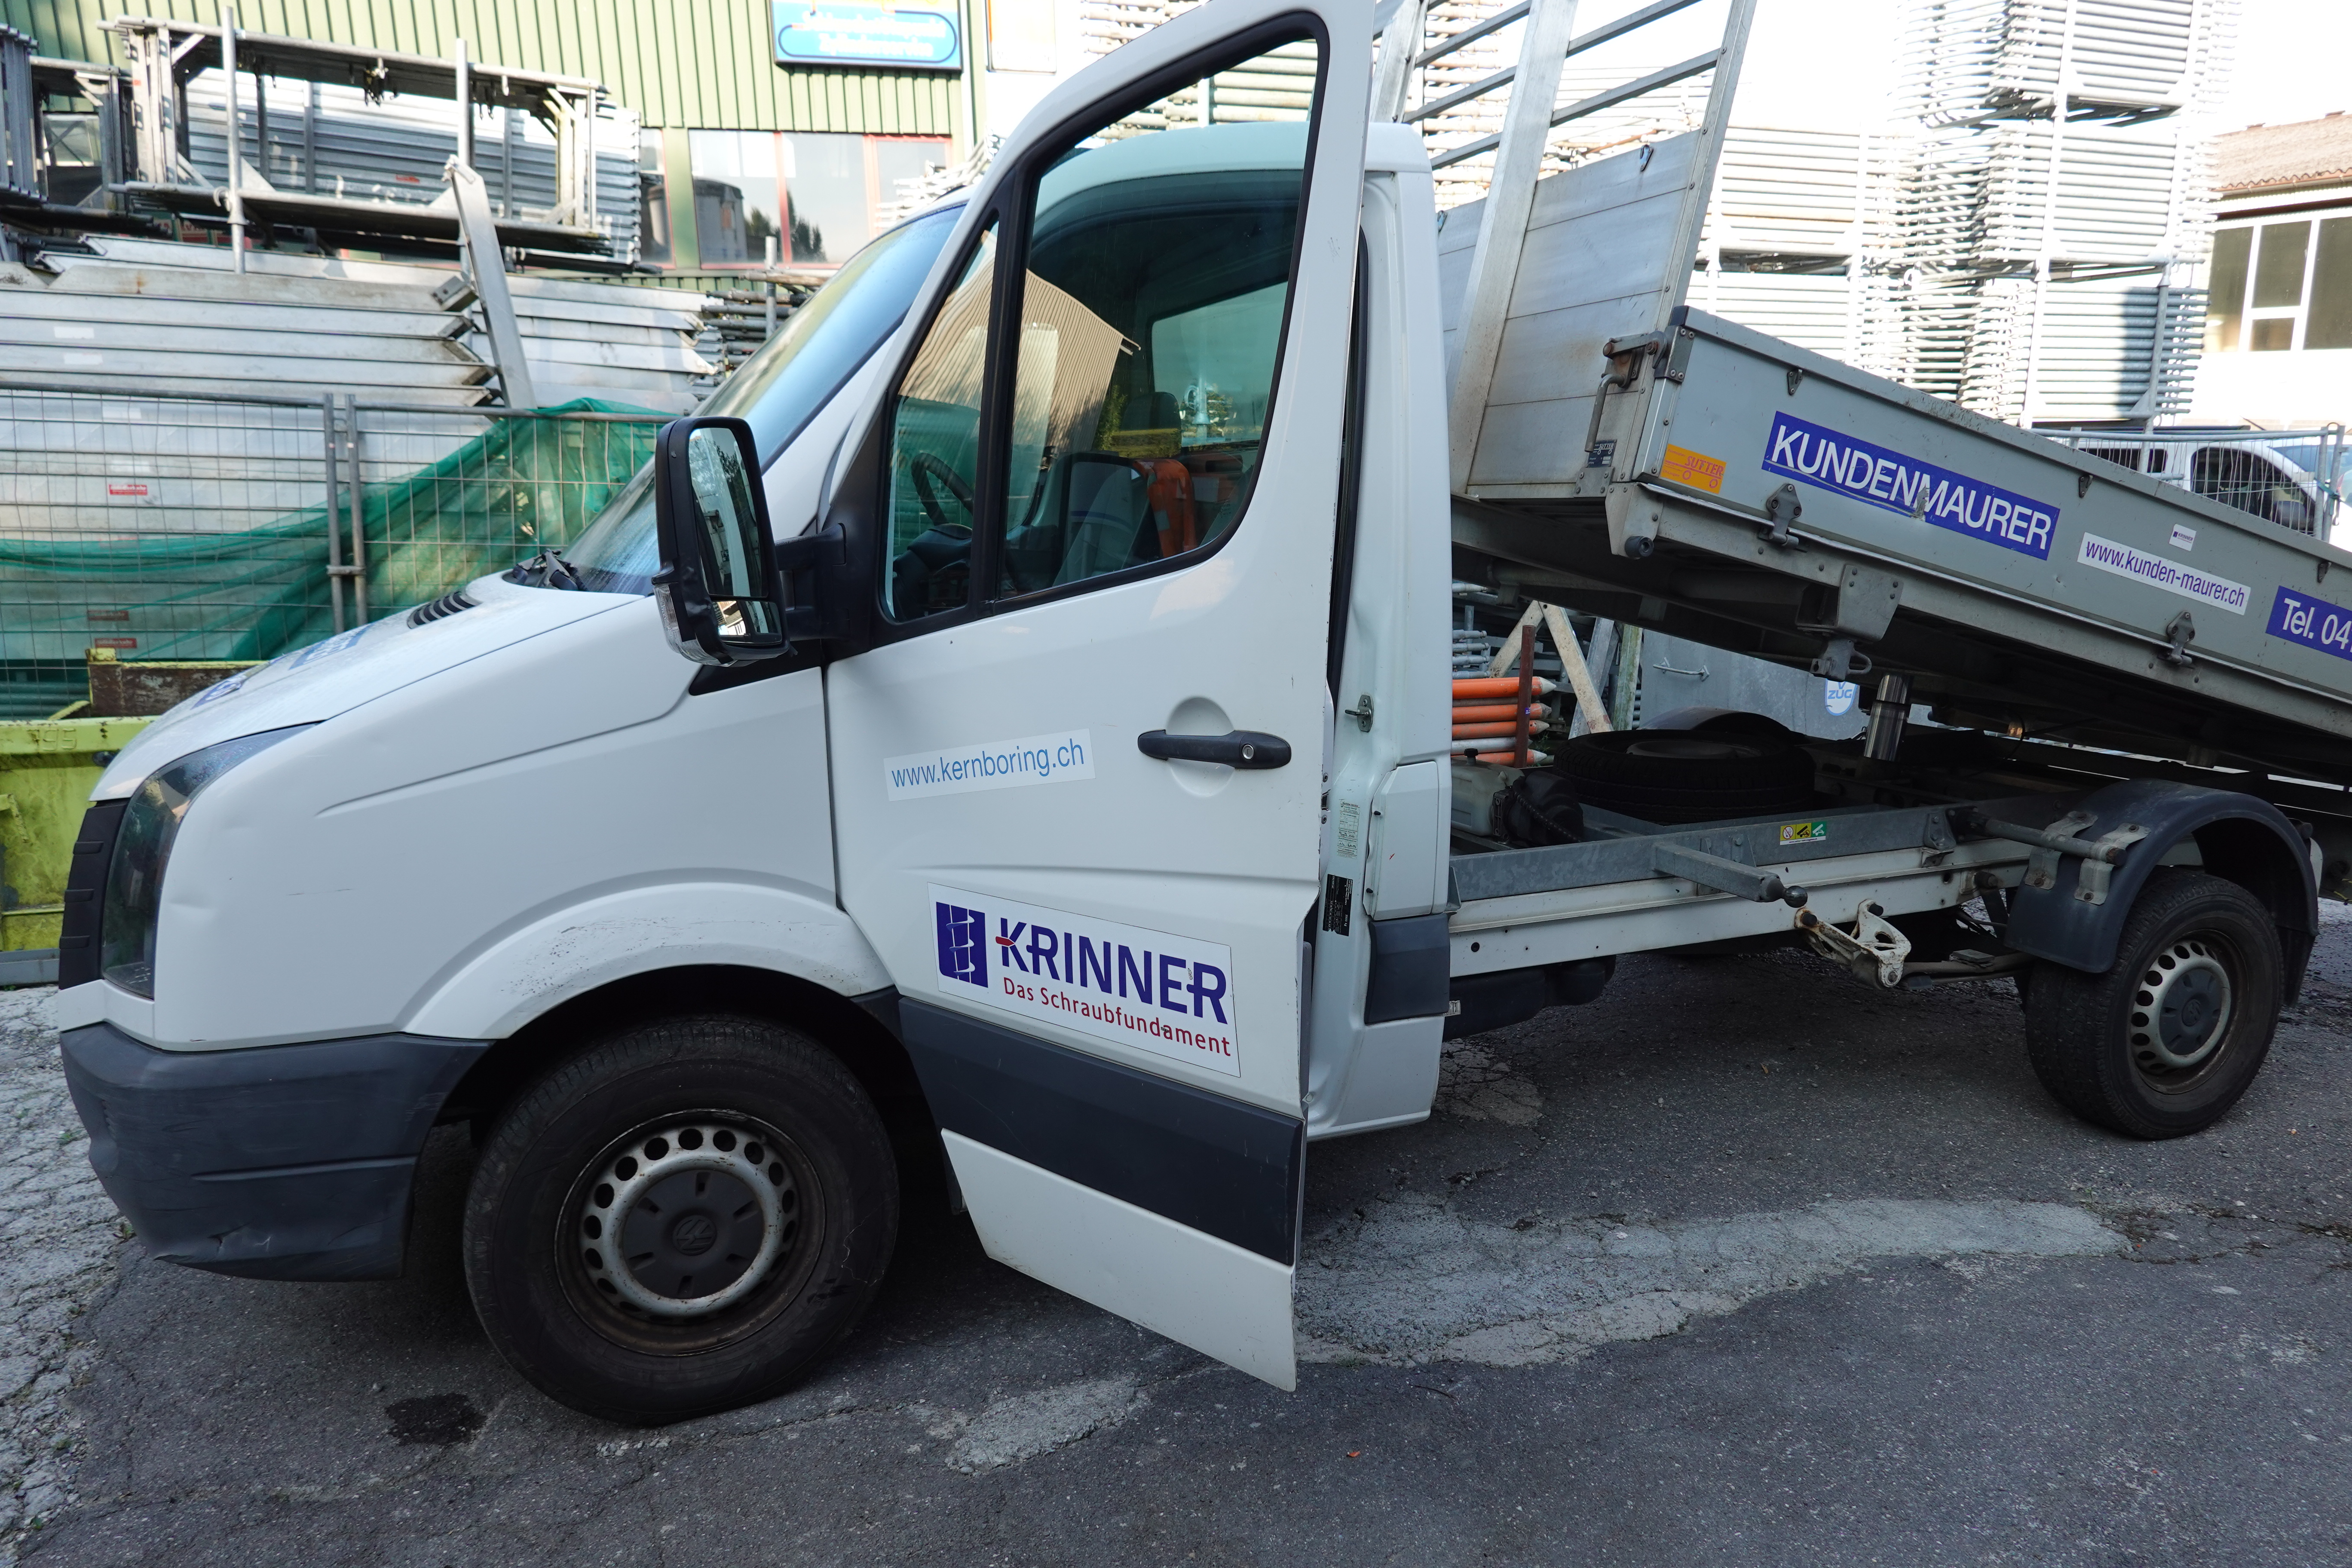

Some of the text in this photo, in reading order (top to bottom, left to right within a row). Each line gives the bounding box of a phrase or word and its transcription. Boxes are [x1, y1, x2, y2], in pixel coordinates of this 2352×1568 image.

[1685, 456, 1724, 477] SUTTER
[2086, 541, 2245, 607] www.kunden-maurer.ch
[2282, 598, 2315, 639] Tel.
[1828, 689, 1853, 699] ZUG
[1838, 681, 1846, 689] V
[892, 738, 1084, 788] www.kernboring.ch
[995, 918, 1228, 1025] KRINNER
[1003, 977, 1231, 1057] Das Schraubfundament
